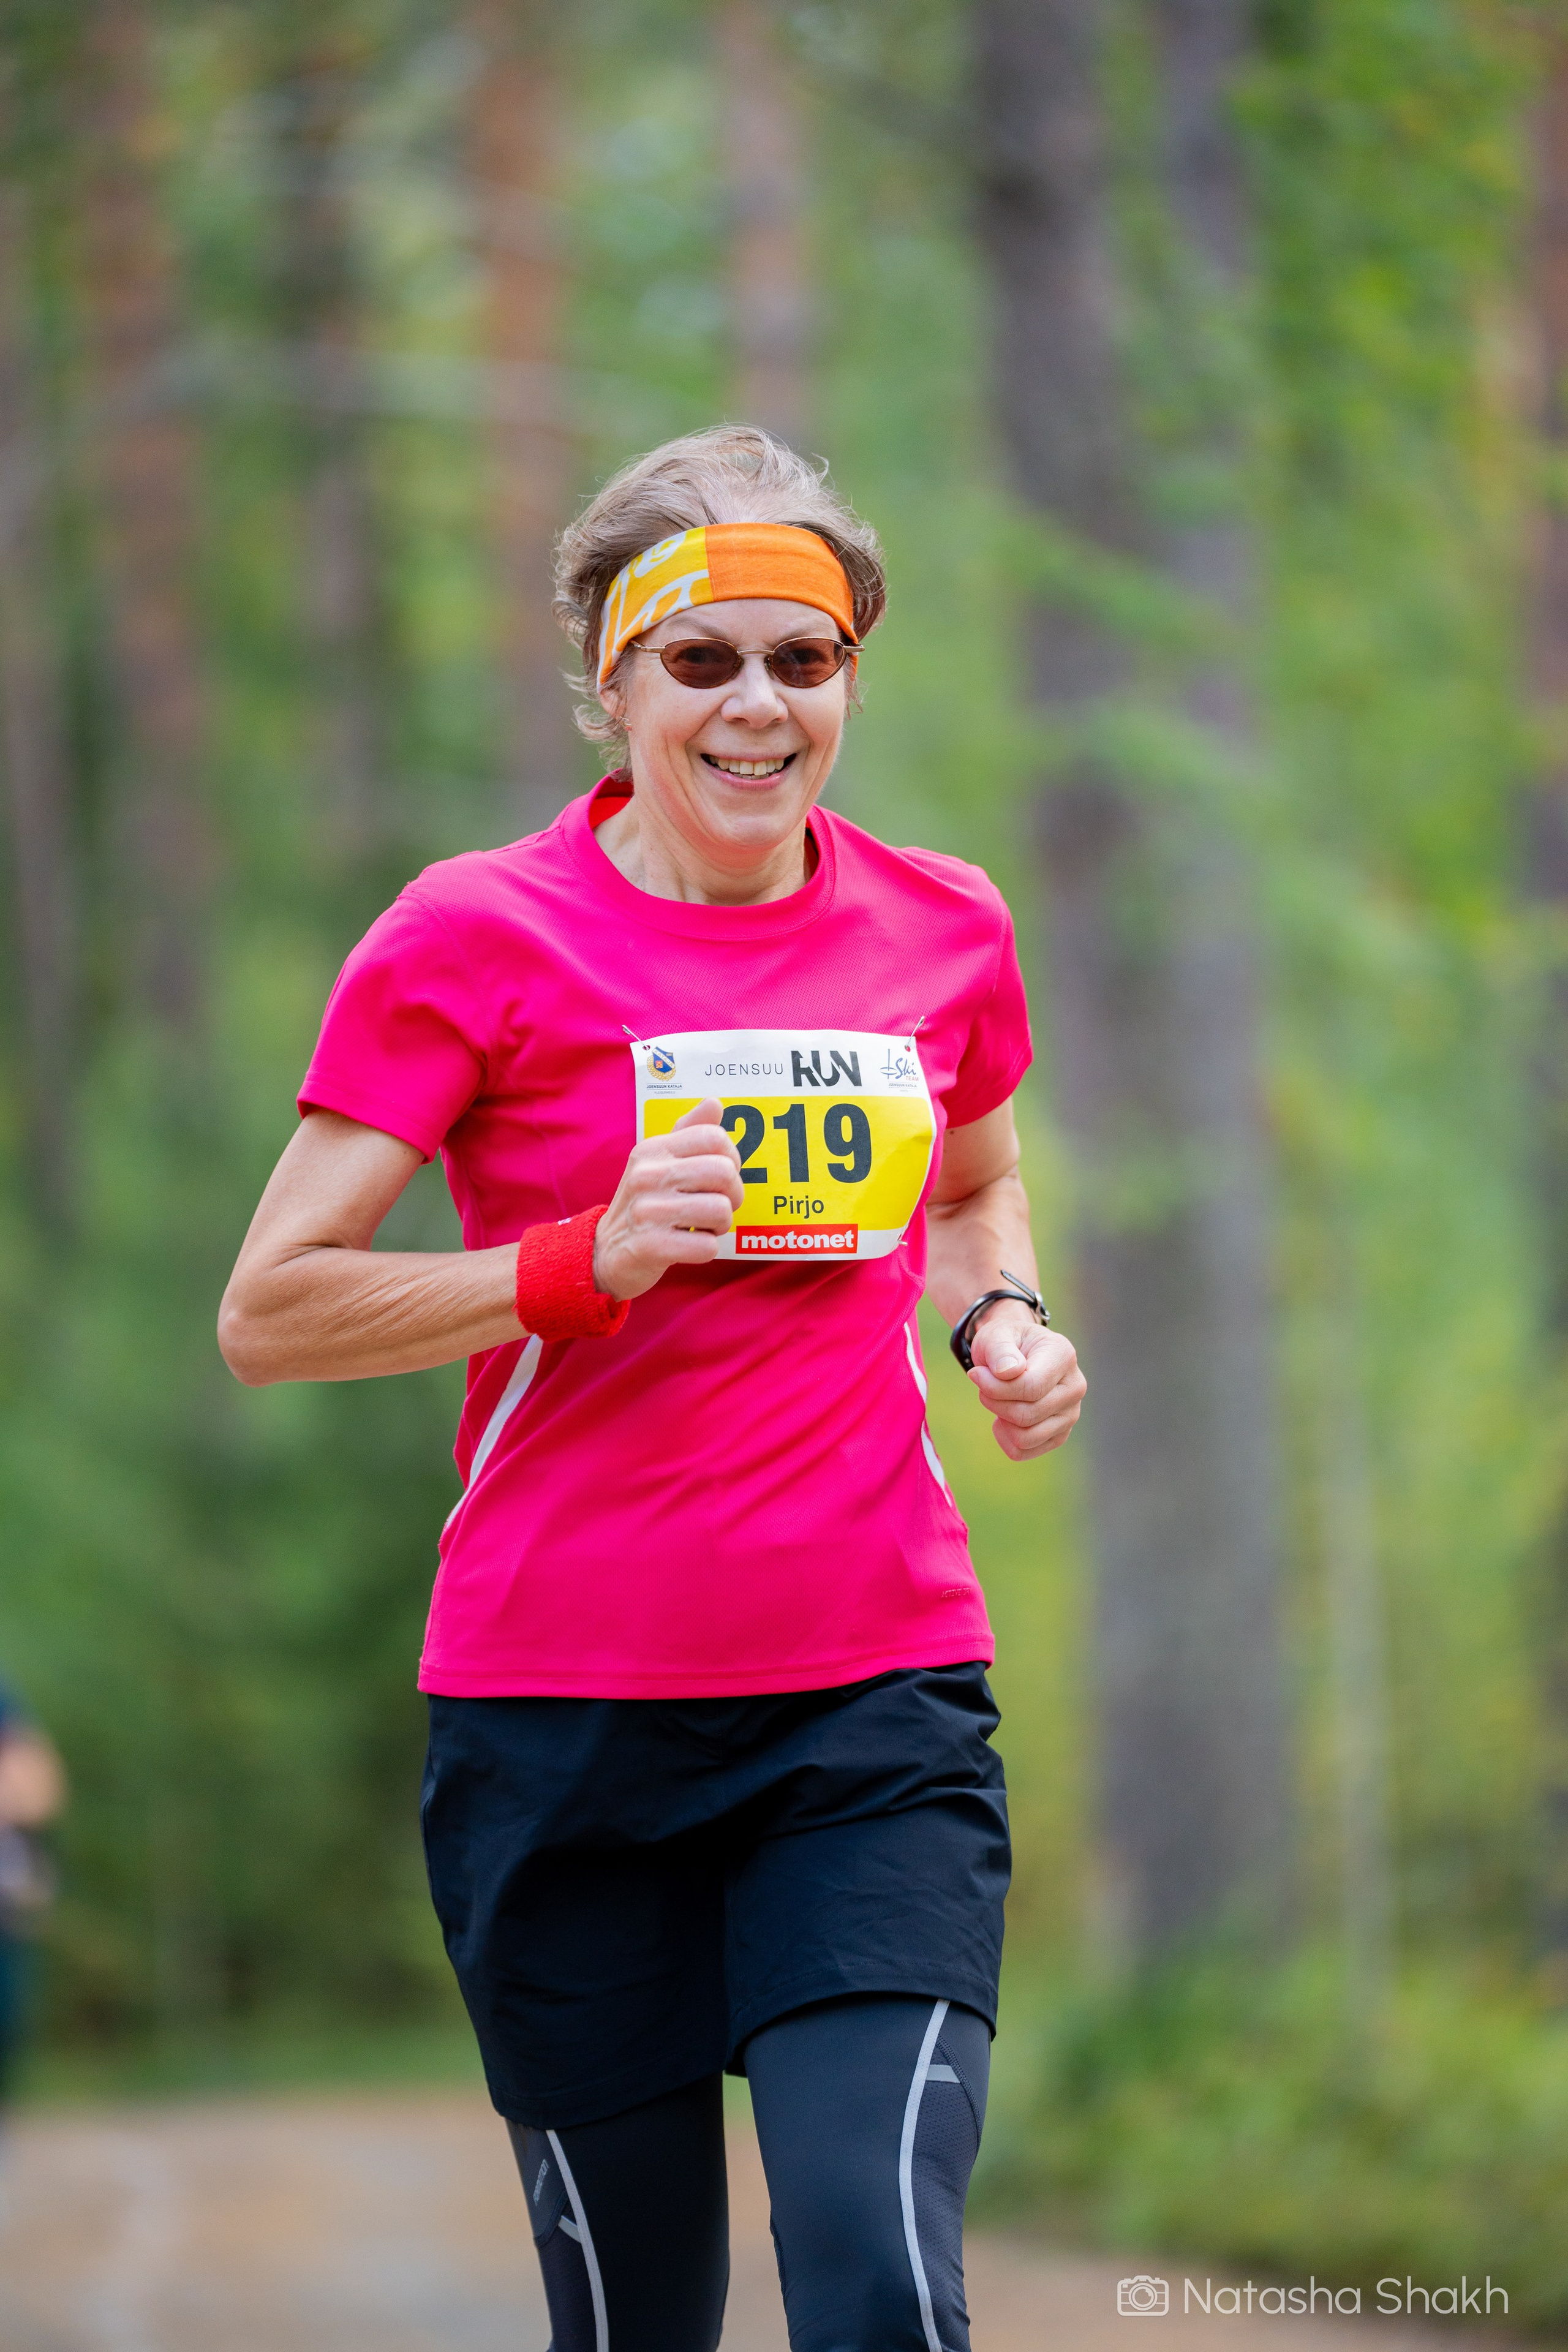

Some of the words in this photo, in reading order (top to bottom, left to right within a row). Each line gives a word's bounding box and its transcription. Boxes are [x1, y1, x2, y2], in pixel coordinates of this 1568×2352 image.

[654, 1049, 673, 1067] KATAJA
[705, 1063, 783, 1076] JOENSUU
[791, 1050, 862, 1087] RUN
[895, 1057, 916, 1079] Ski
[719, 1103, 872, 1184] 219
[774, 1195, 824, 1219] Pirjo
[741, 1229, 854, 1249] motonet
[941, 1588, 962, 1598] ACTIVE
